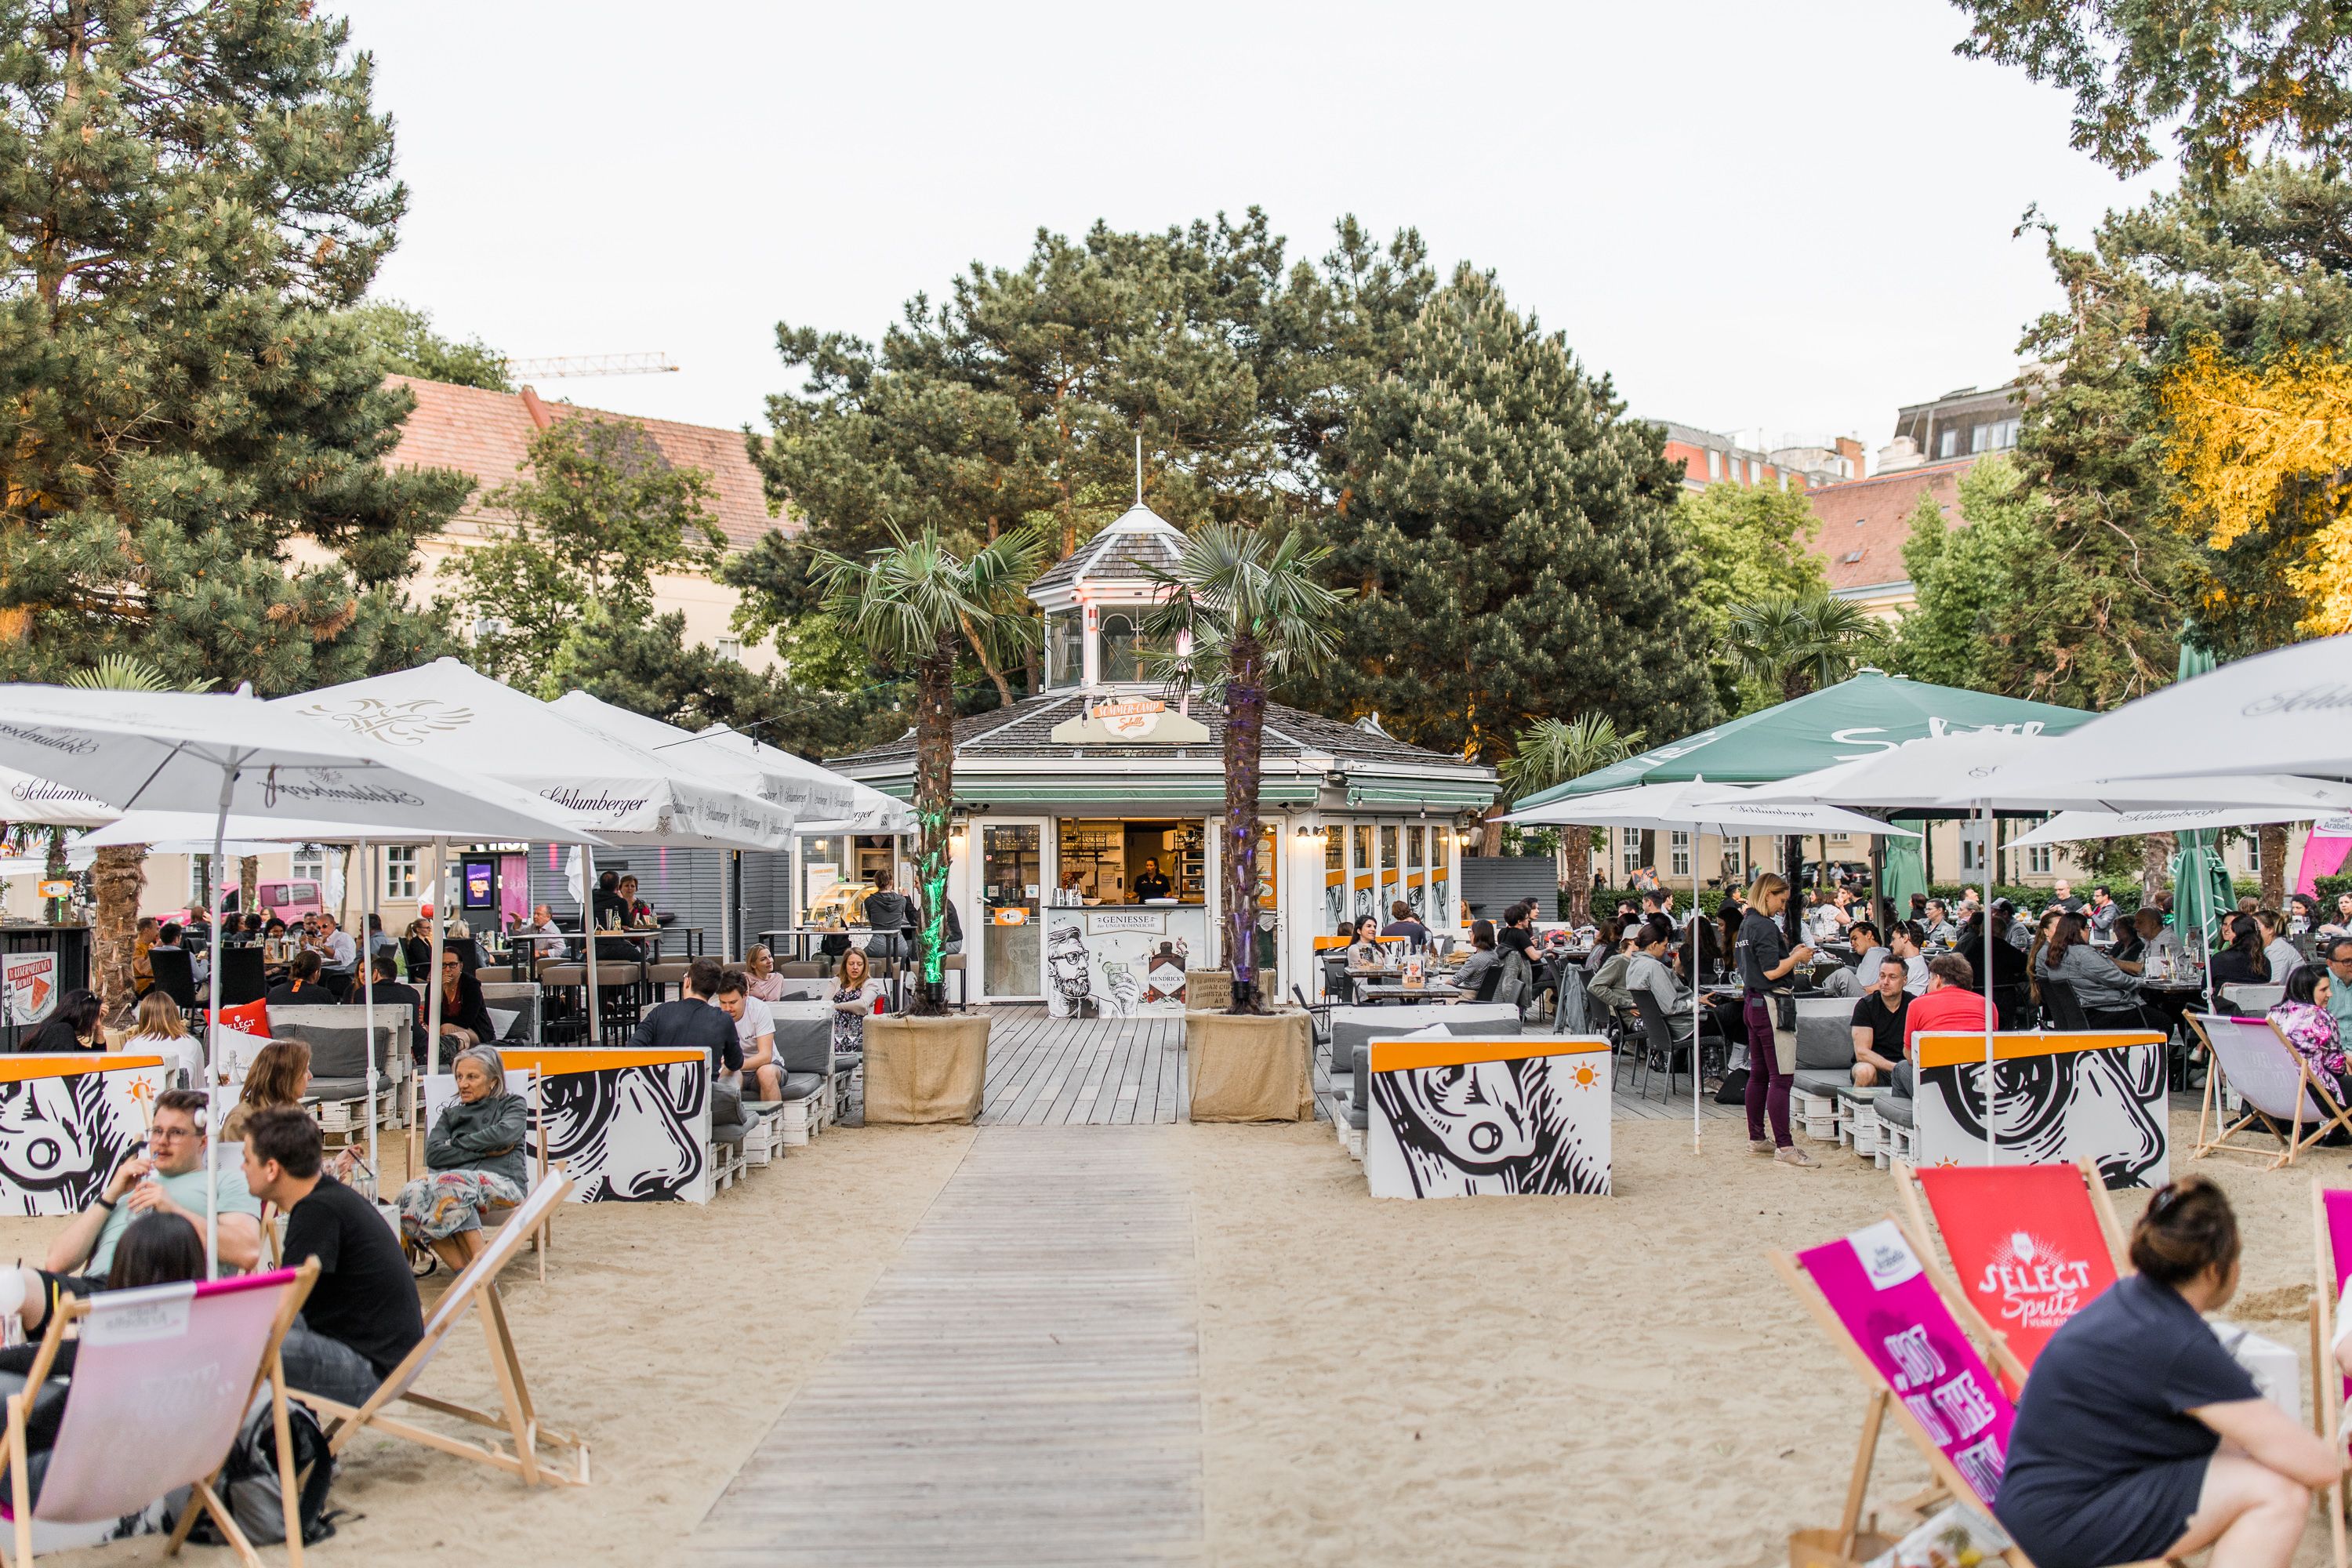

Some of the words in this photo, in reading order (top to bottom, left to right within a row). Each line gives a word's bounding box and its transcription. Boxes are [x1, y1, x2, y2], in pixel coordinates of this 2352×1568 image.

[1098, 702, 1159, 717] SOMMER-CAMP
[1979, 1261, 2090, 1293] SELECT
[2001, 1290, 2081, 1329] Spritz
